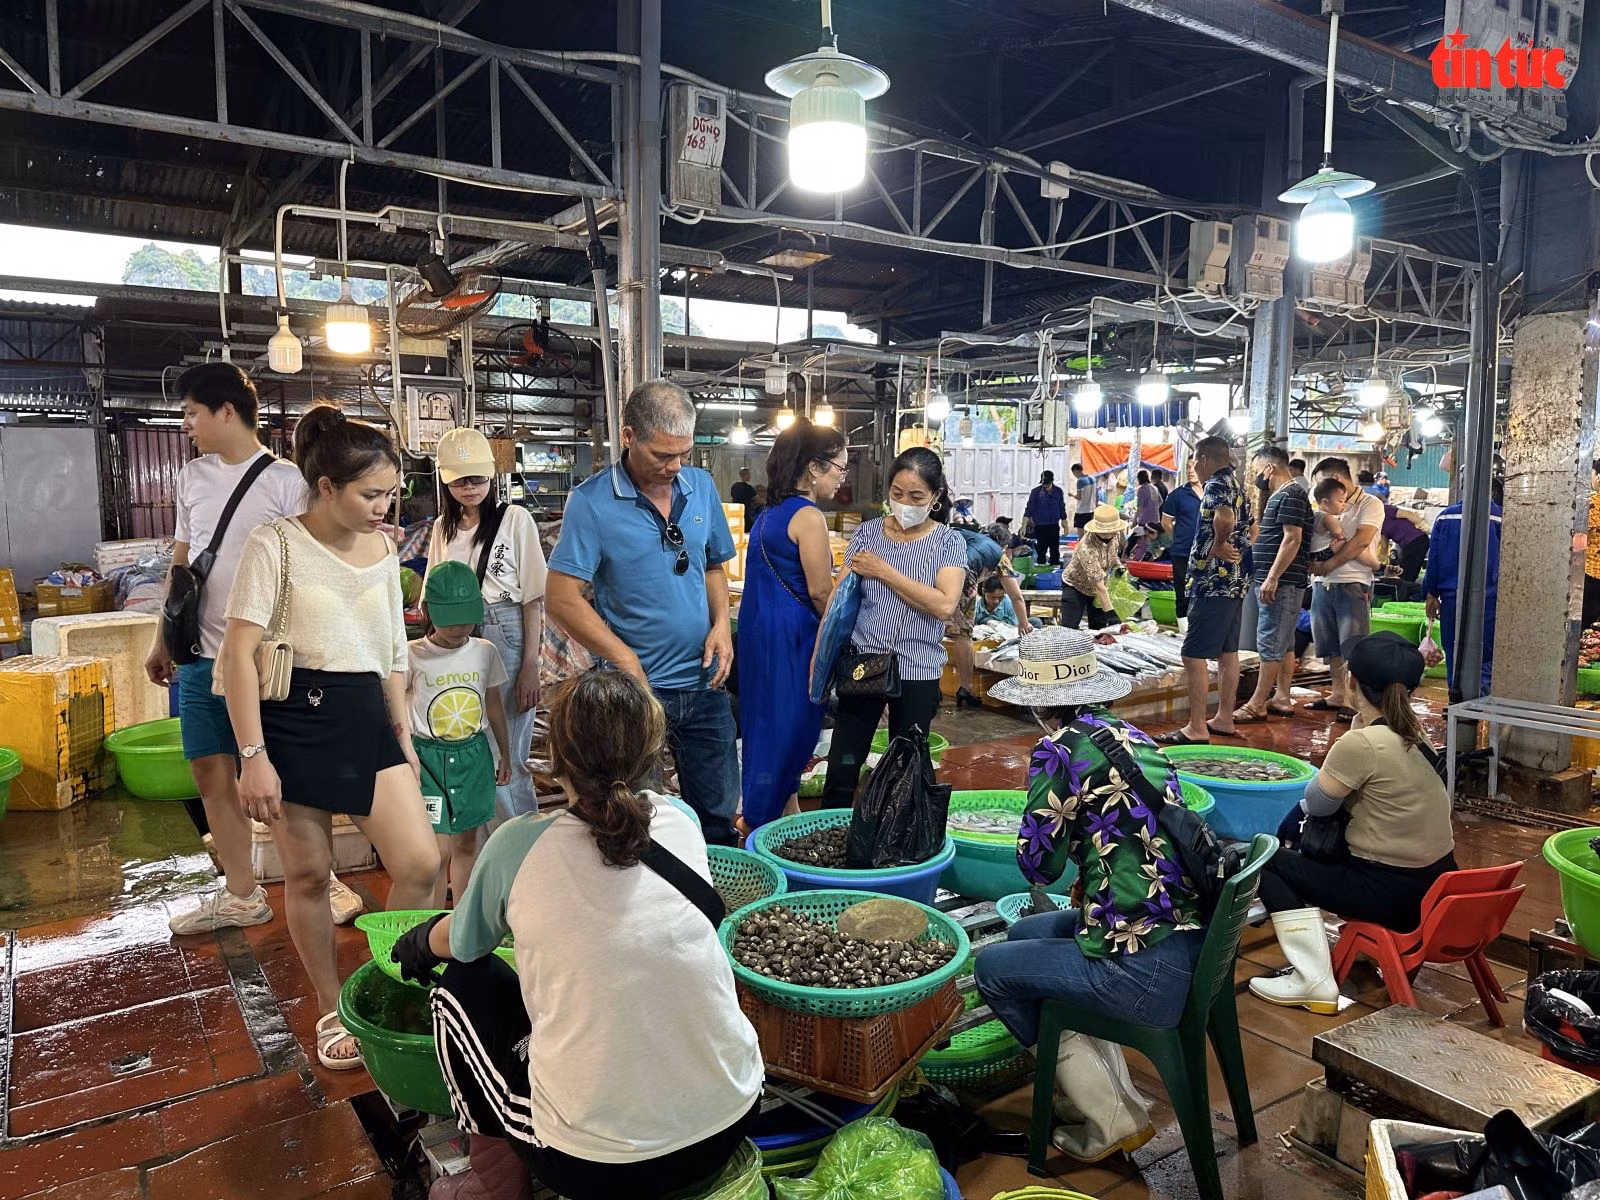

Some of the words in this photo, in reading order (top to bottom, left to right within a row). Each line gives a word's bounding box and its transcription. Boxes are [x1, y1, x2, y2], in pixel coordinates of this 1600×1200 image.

[687, 133, 706, 150] 168
[422, 671, 480, 688] Lemon
[1051, 663, 1091, 681] Dior
